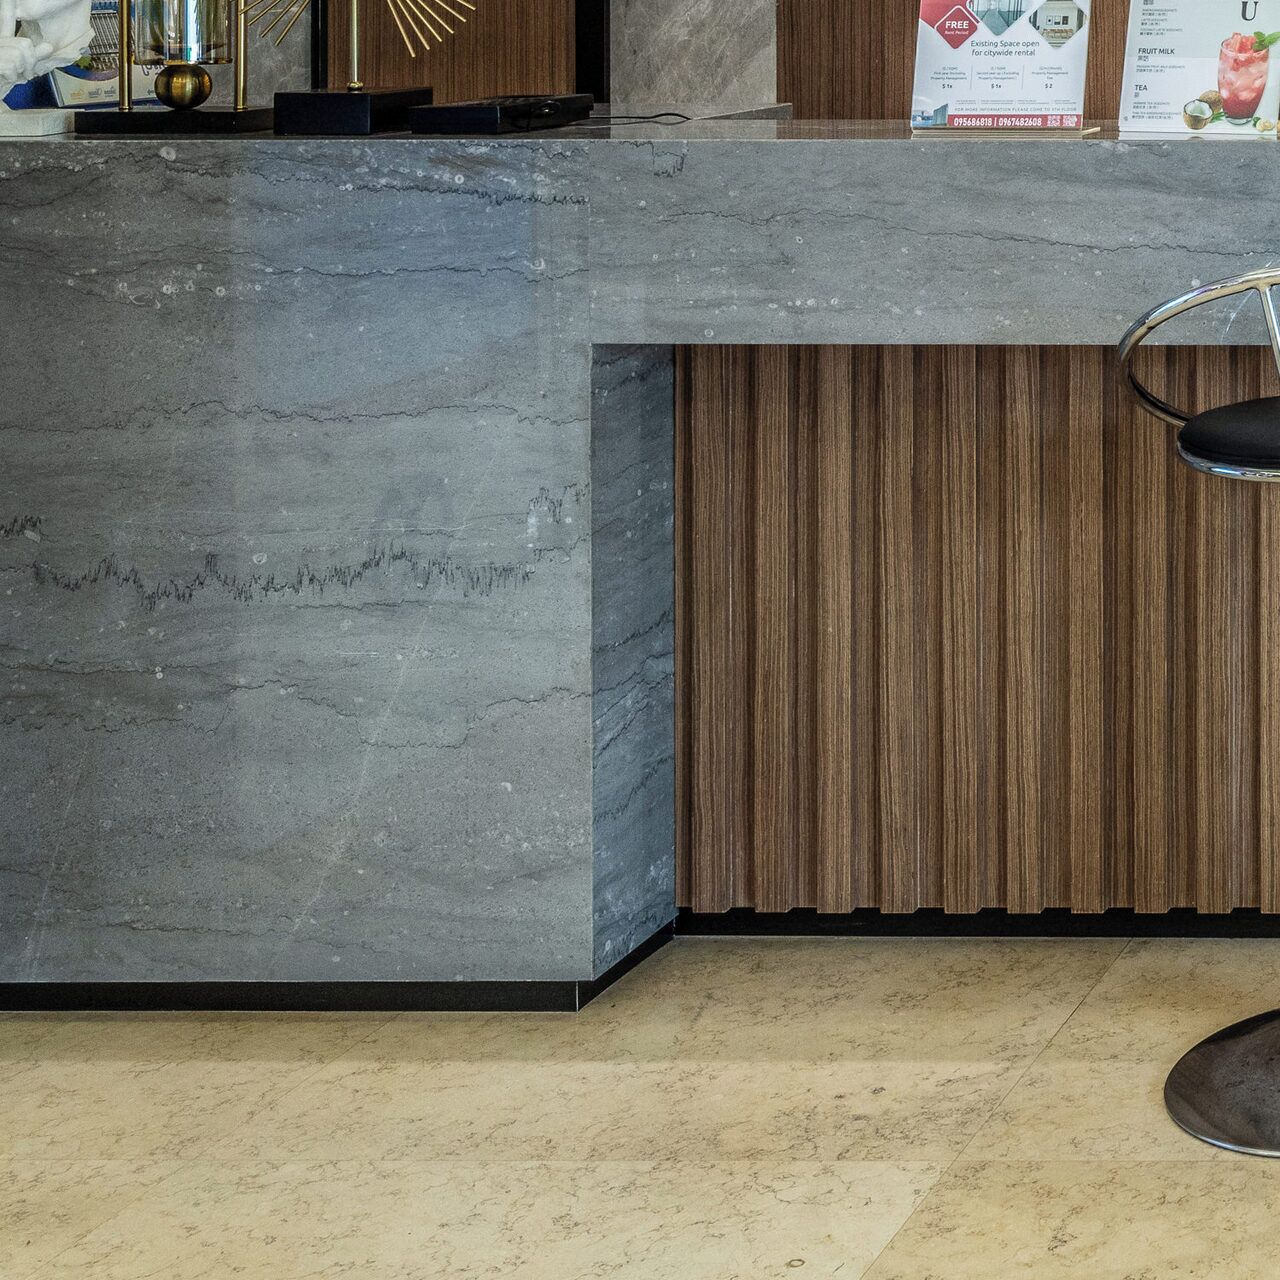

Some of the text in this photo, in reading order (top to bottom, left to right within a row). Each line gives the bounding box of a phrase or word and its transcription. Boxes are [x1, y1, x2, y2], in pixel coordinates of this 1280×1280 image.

[984, 49, 1013, 57] citywide
[954, 117, 1042, 126] 095686818 0967482608
